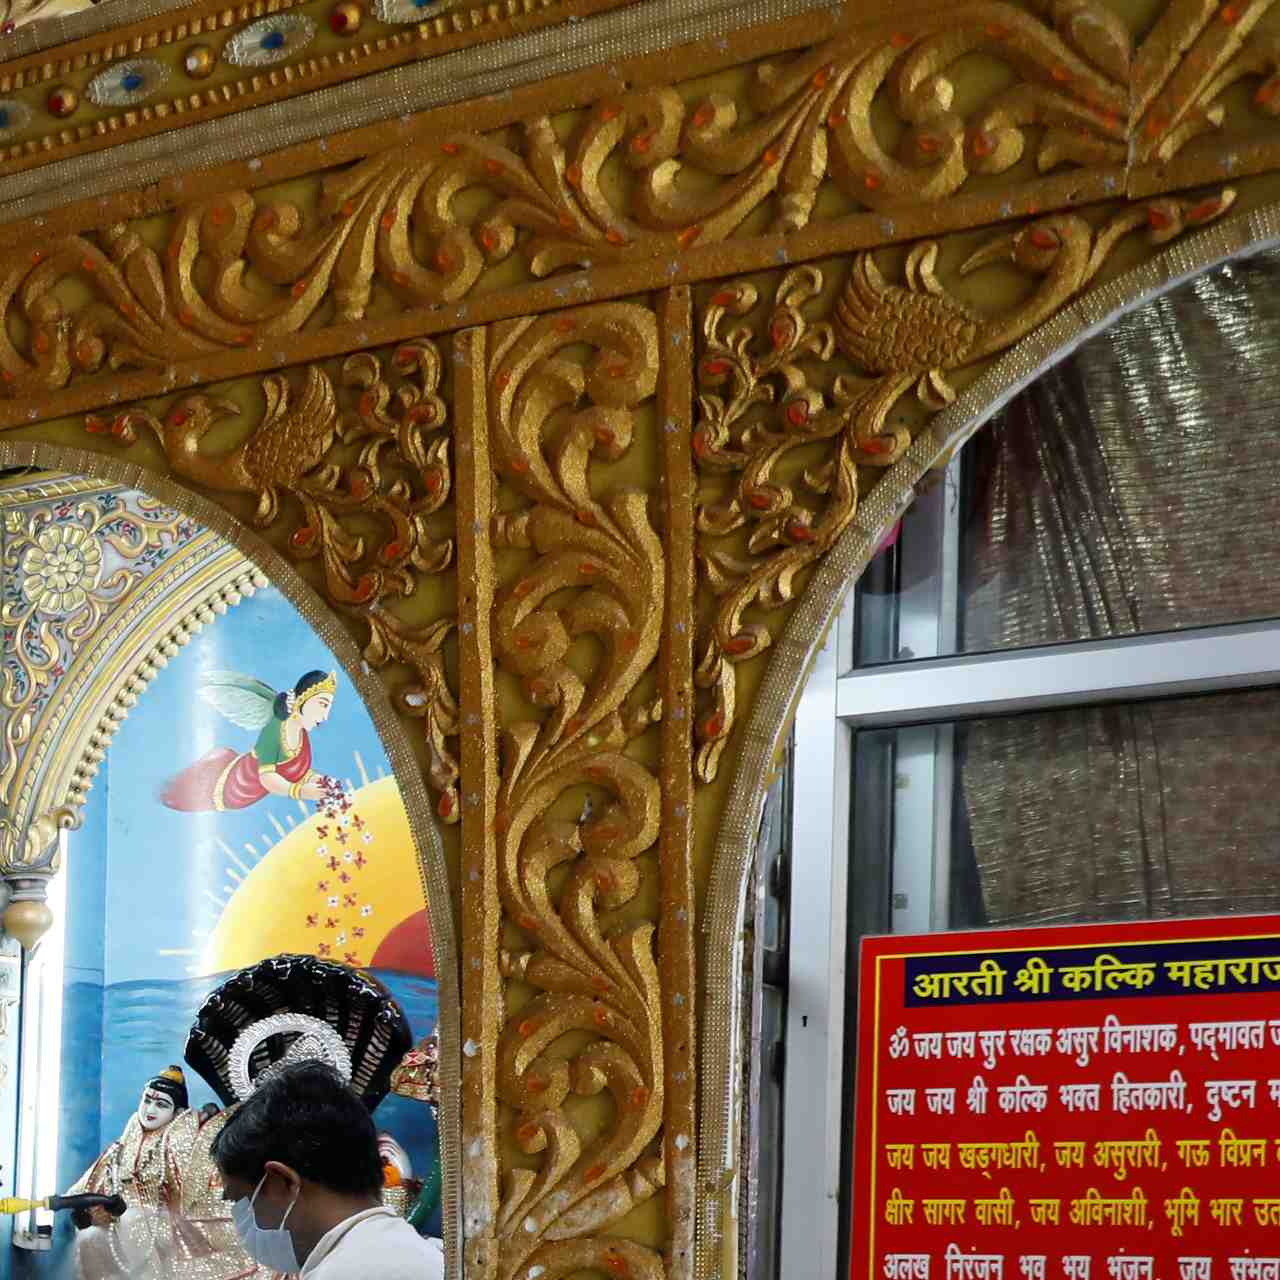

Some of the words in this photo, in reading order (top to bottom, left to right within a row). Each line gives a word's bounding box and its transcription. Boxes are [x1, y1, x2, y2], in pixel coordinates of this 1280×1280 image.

[913, 960, 1007, 998] आरती
[1013, 957, 1054, 993] श्री
[1058, 954, 1156, 992] कल्कि
[912, 1033, 943, 1059] जय
[944, 1032, 976, 1058] जय
[978, 1030, 1007, 1069] सुर
[1008, 1029, 1053, 1056] रक्षक
[1056, 1027, 1100, 1067] असुर
[886, 1089, 916, 1115] जय
[925, 1088, 956, 1114] जय
[966, 1075, 988, 1113] श्री
[997, 1075, 1048, 1113] कल्कि
[1059, 1084, 1100, 1112] भक्त
[885, 1144, 915, 1169] जय
[921, 1144, 951, 1169] जय
[1054, 1142, 1085, 1168] जय
[1176, 1140, 1210, 1167] गऊ
[1218, 1128, 1267, 1167] विप्रन
[885, 1188, 914, 1224] क्षीर
[922, 1199, 966, 1224] सागर
[1029, 1199, 1060, 1225] जय
[1164, 1187, 1200, 1236] भूमि
[1210, 1199, 1243, 1225] भार
[883, 1254, 930, 1280] अलख
[944, 1243, 1004, 1280] निरंजन
[1019, 1255, 1046, 1280] भव
